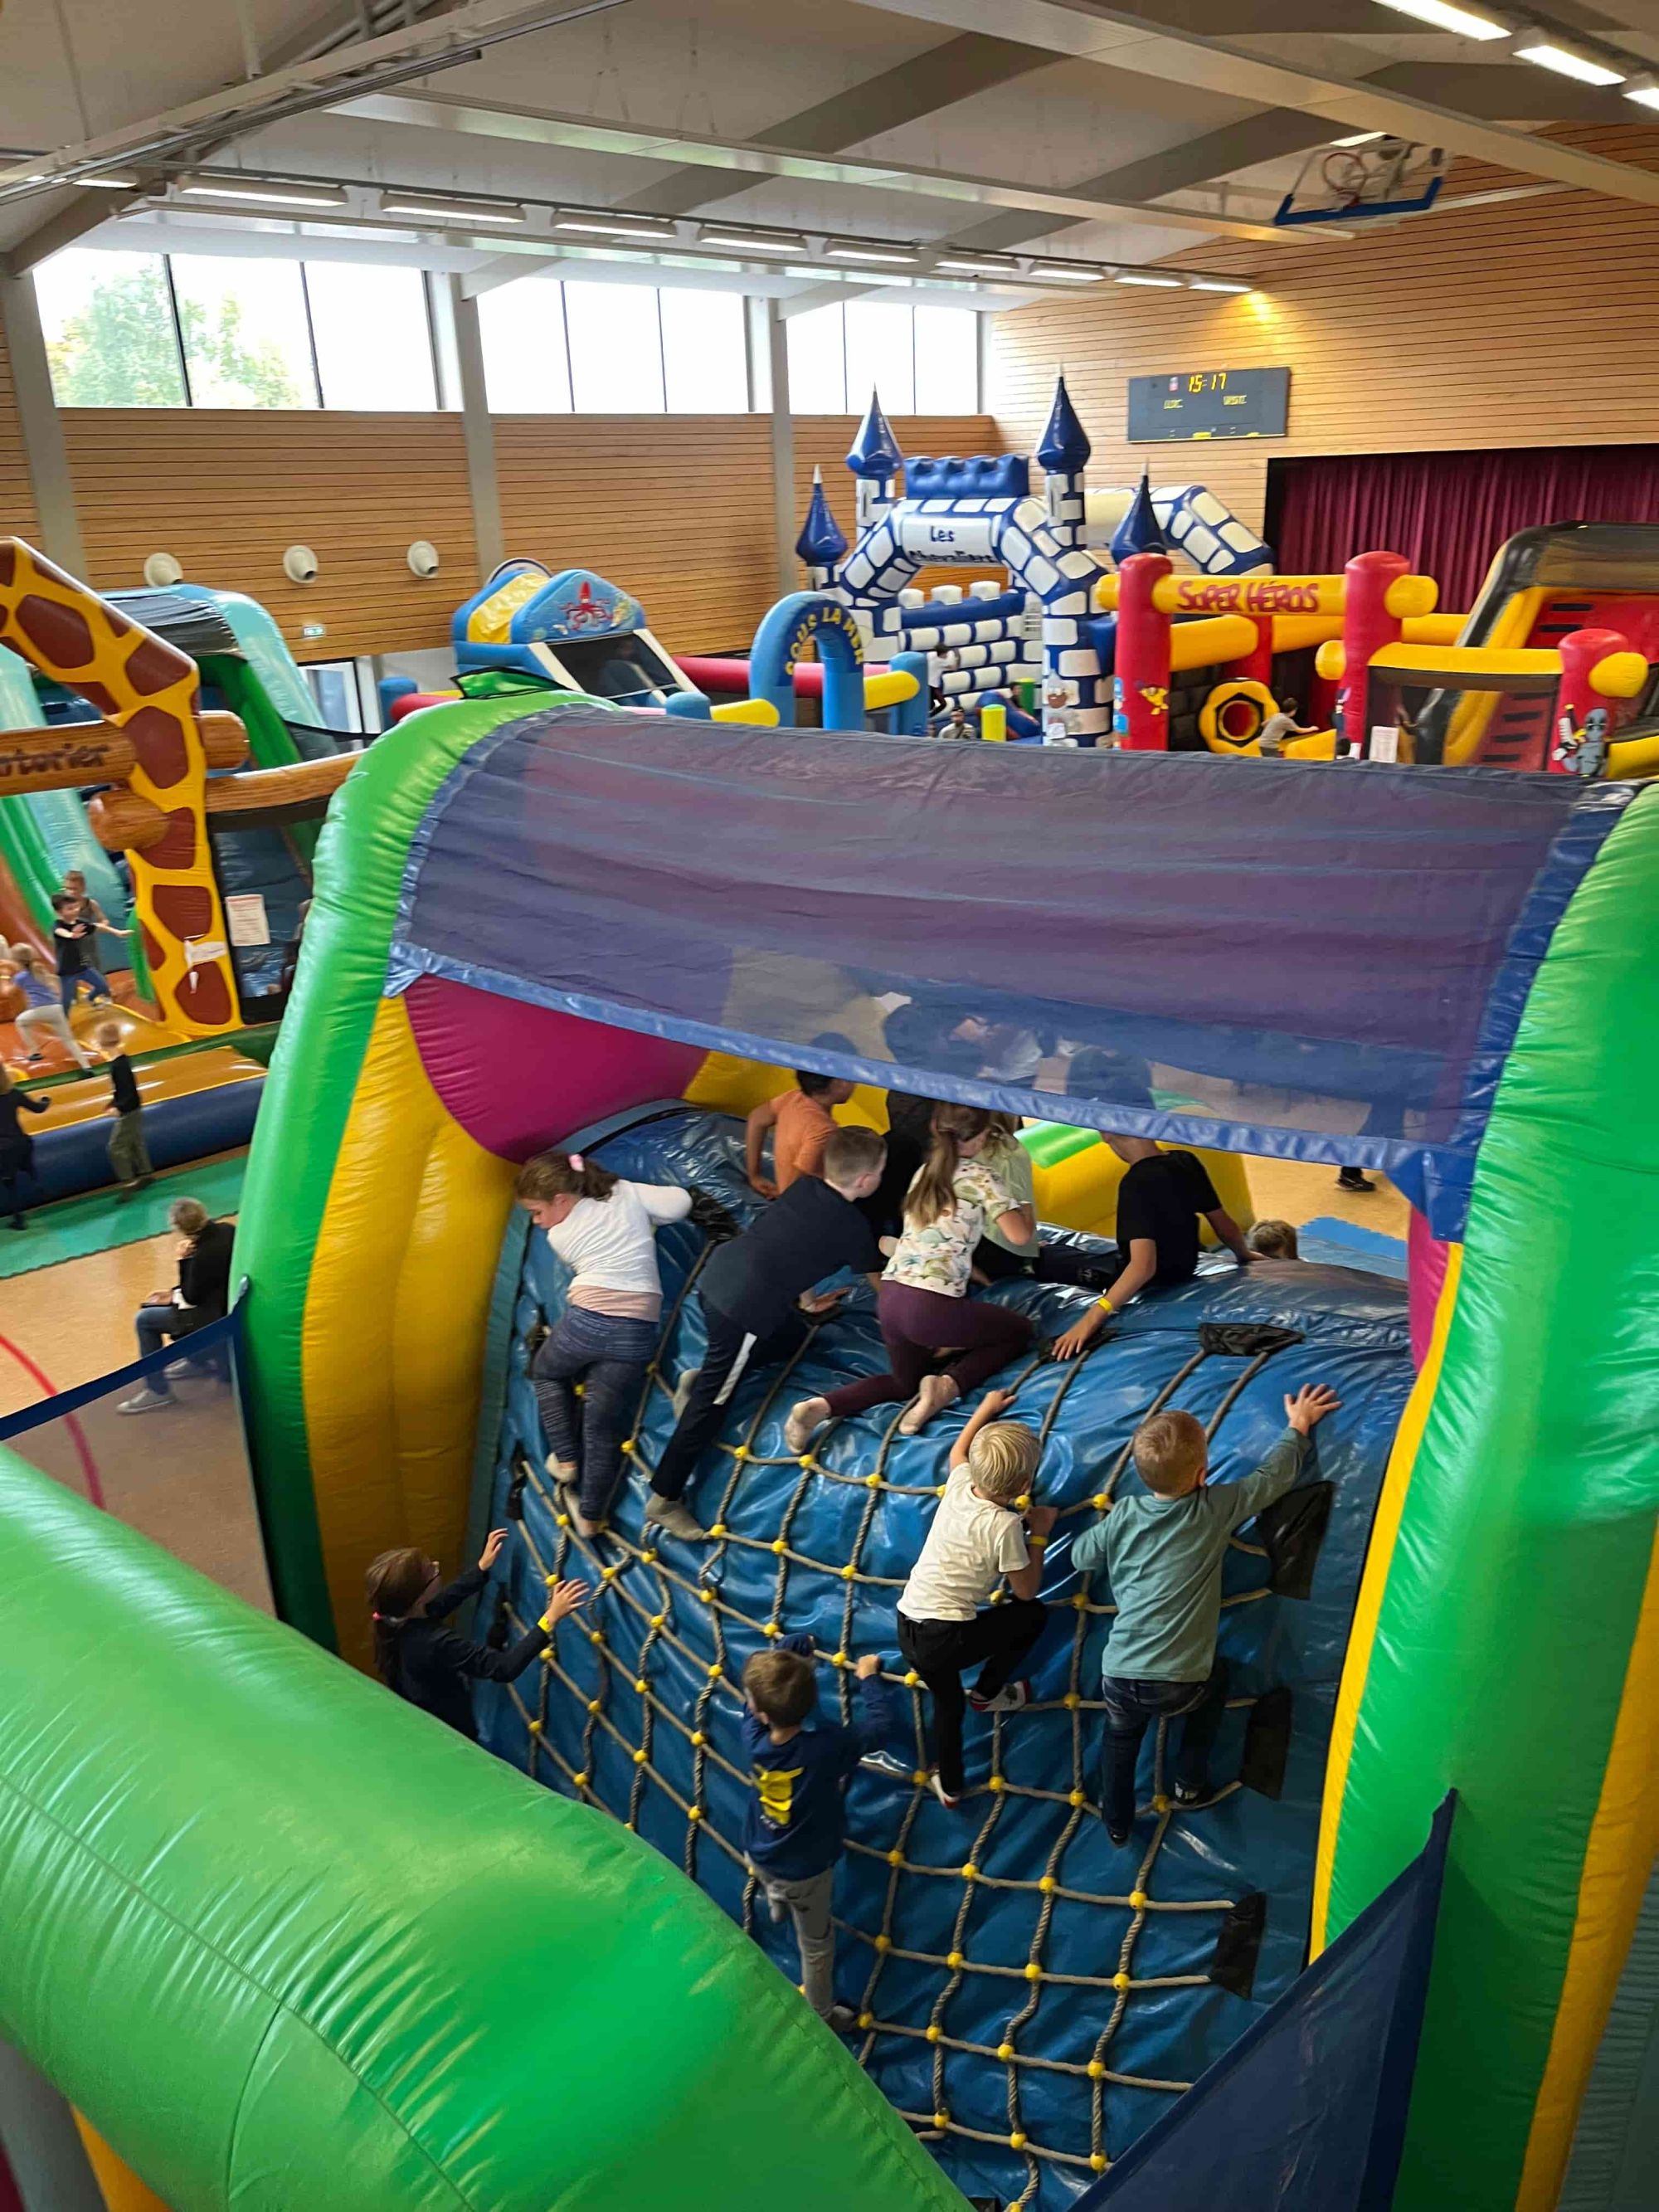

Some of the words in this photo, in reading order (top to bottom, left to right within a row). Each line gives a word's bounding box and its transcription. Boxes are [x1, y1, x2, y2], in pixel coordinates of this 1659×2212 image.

[1188, 373, 1227, 394] 15:17
[930, 525, 956, 543] Les
[785, 613, 817, 676] SOUS
[822, 607, 842, 625] LA
[842, 617, 864, 665] MER
